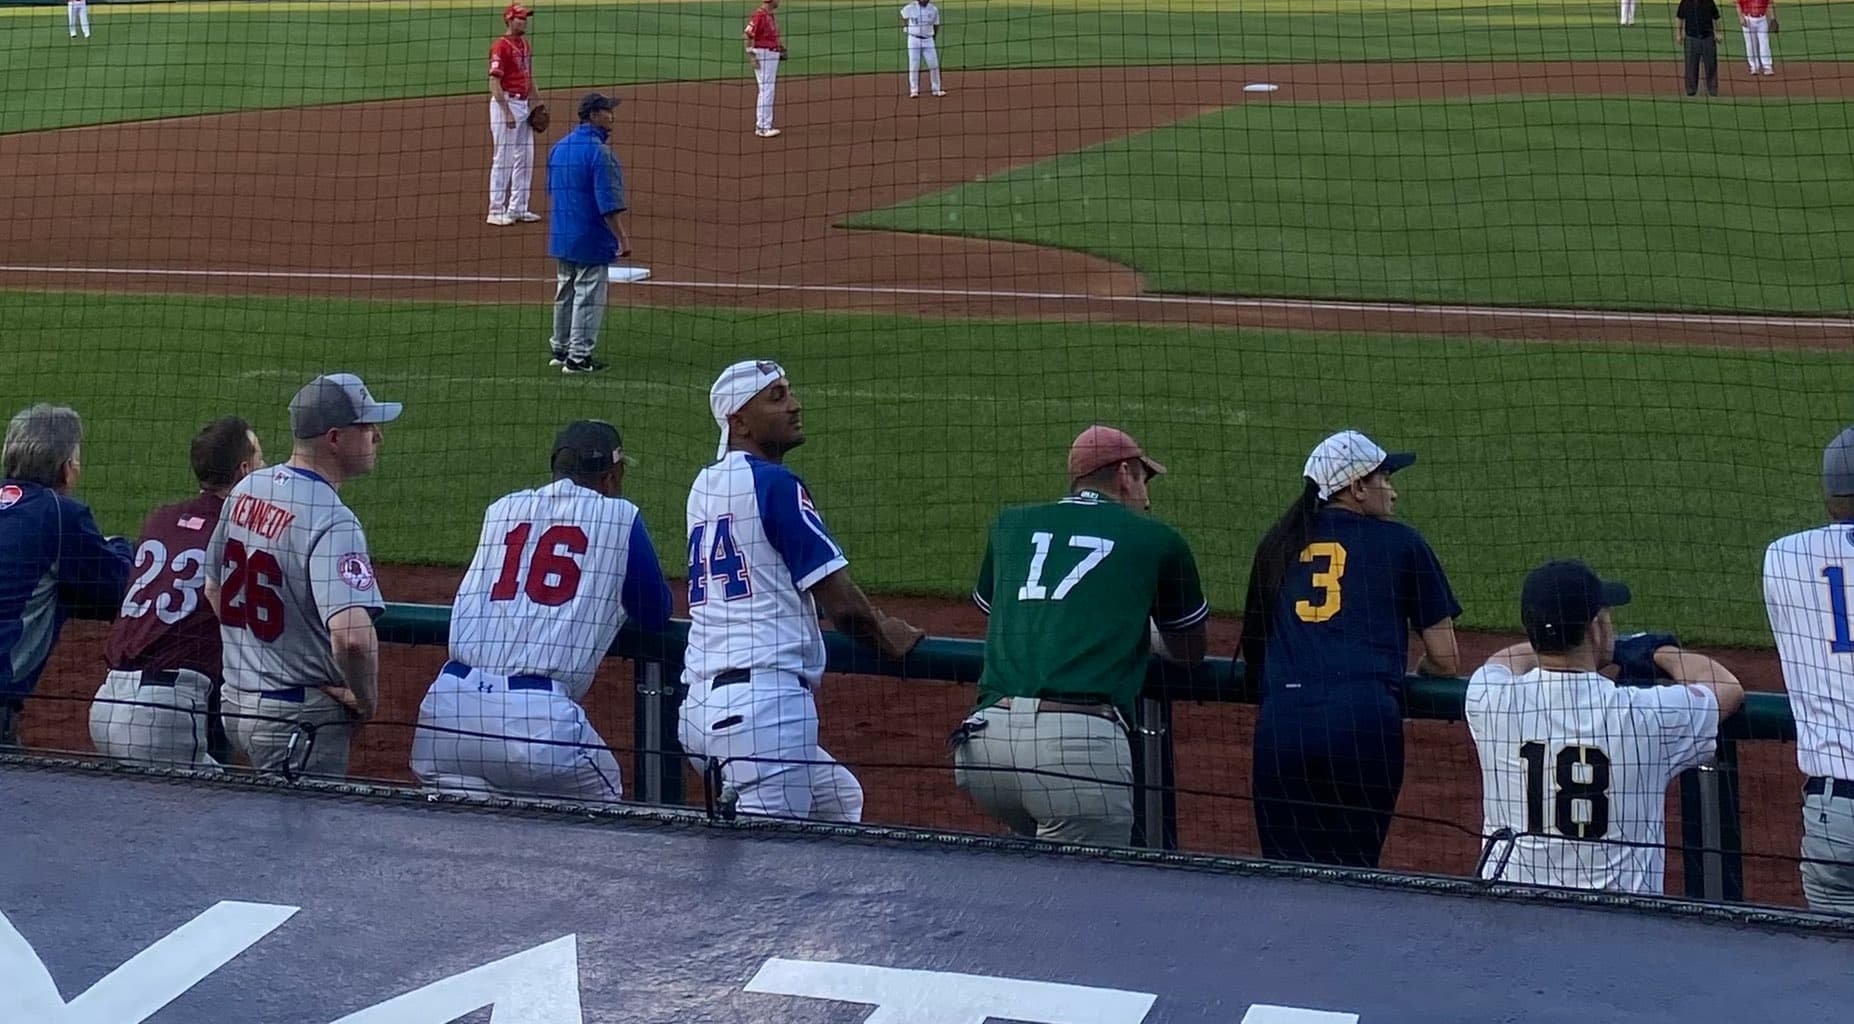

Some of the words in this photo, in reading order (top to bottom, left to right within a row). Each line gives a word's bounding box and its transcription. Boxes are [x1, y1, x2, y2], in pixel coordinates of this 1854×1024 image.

[228, 493, 295, 543] KENNEDY
[688, 513, 753, 607] 44
[120, 539, 207, 625] 23
[221, 537, 285, 643] 26
[490, 522, 589, 607] 16
[1018, 531, 1115, 601] 17
[1295, 541, 1348, 624] 3
[1519, 739, 1610, 840] 18
